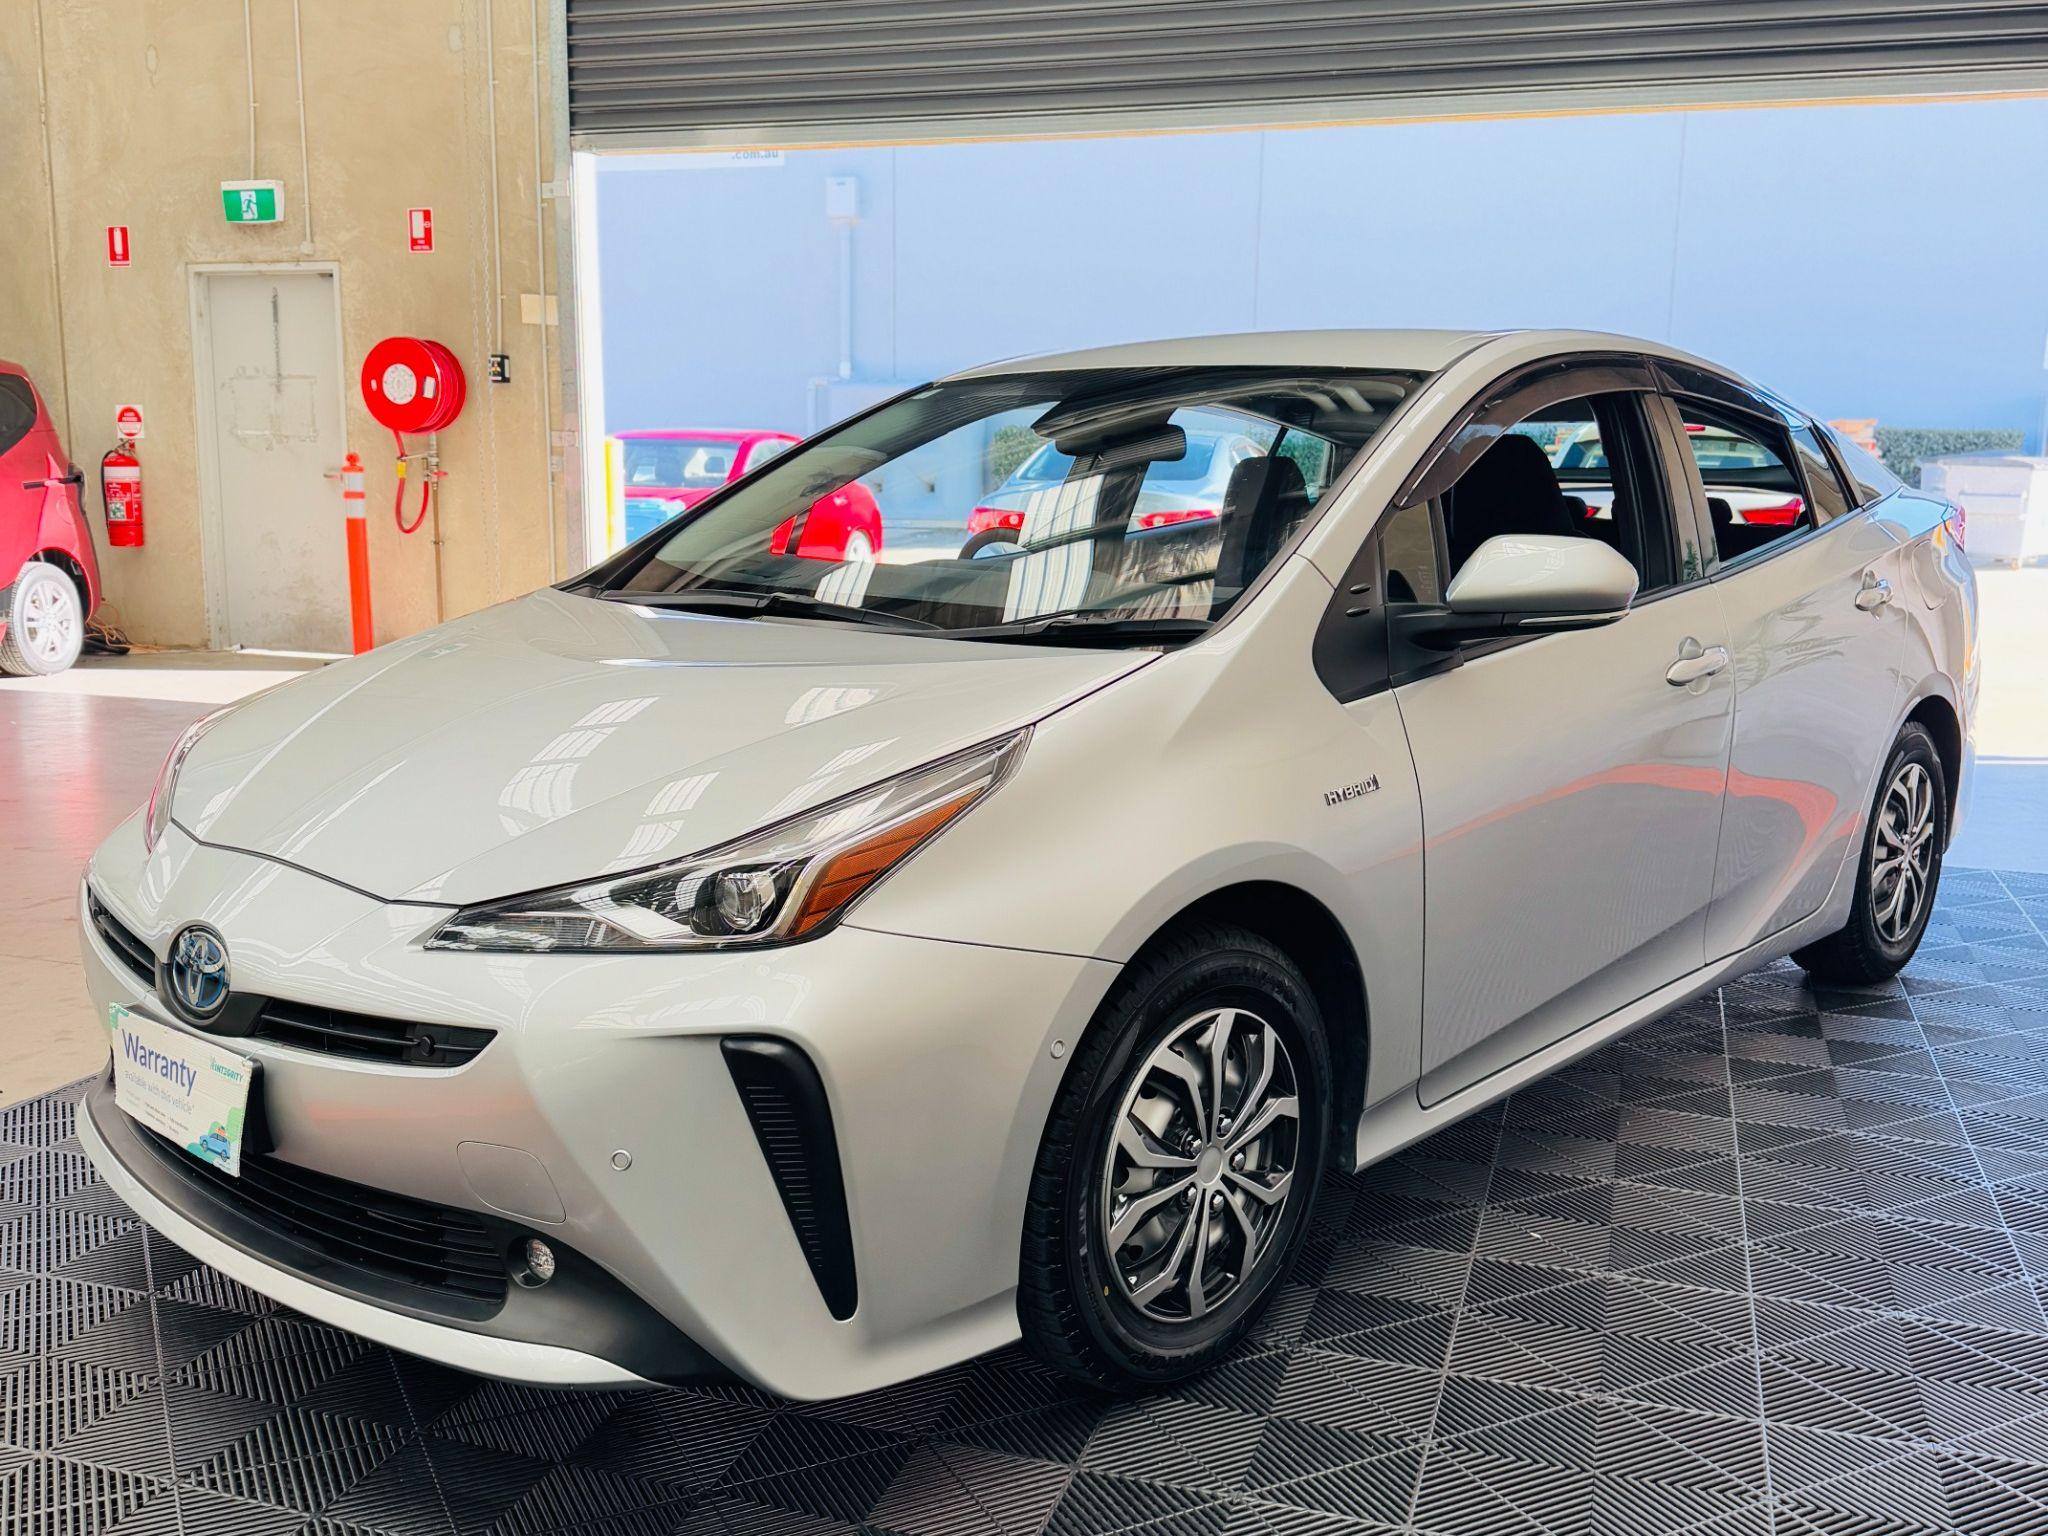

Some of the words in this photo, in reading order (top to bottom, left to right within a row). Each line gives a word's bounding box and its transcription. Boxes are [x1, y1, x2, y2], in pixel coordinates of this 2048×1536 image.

[732, 150, 779, 160] .com.au
[1325, 776, 1376, 805] HYBRID
[121, 1028, 197, 1097] Warranty
